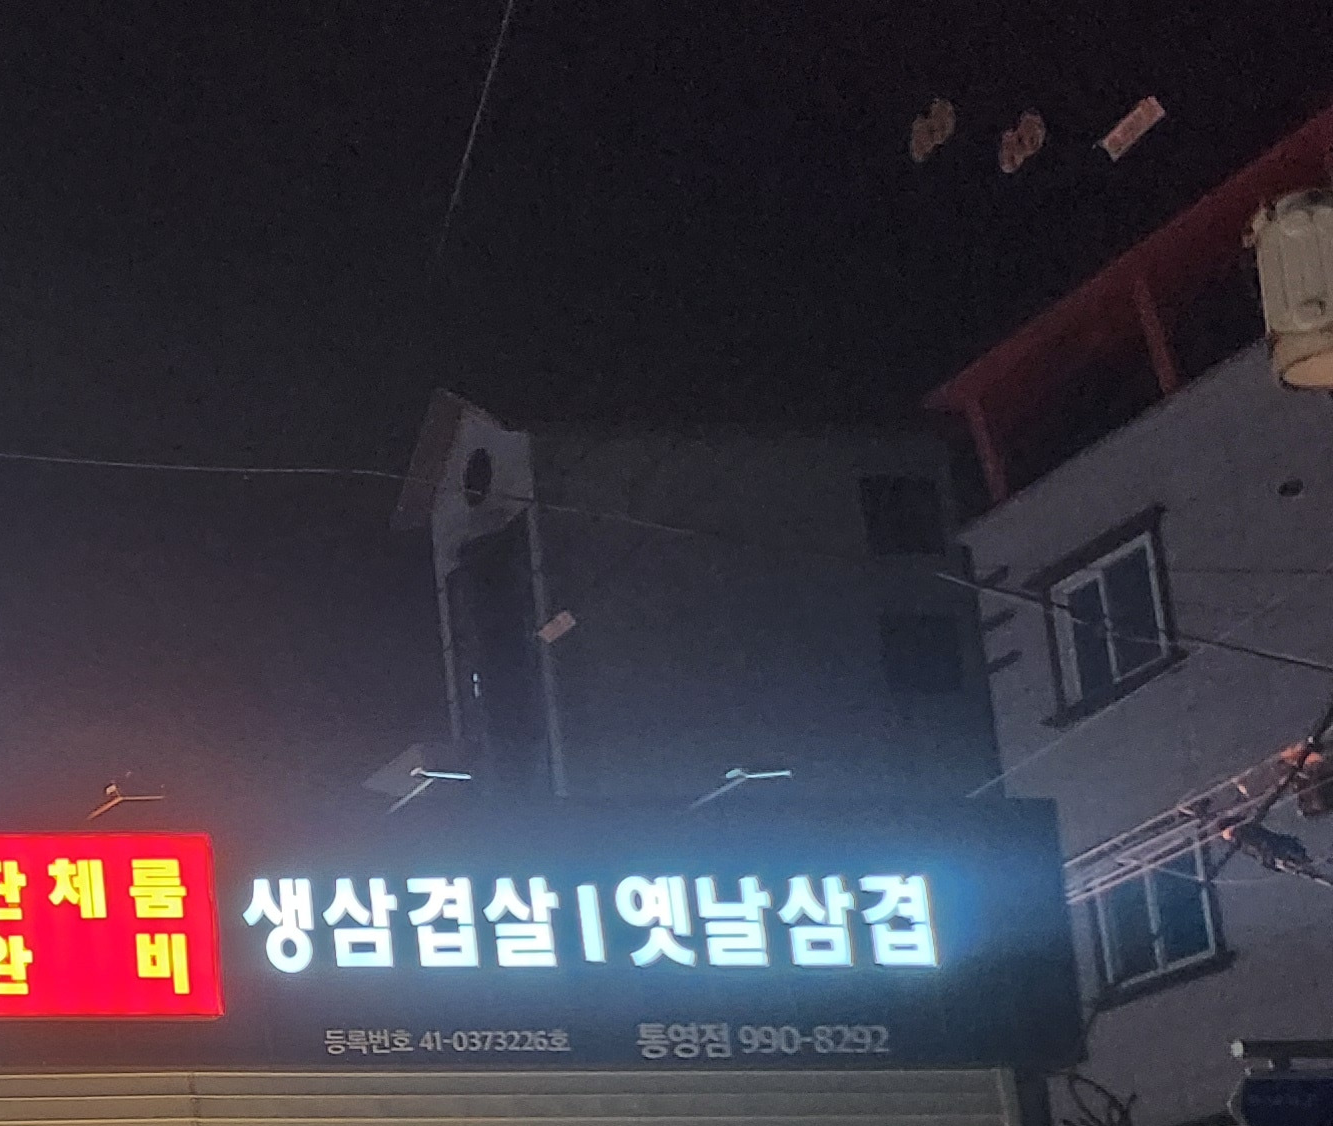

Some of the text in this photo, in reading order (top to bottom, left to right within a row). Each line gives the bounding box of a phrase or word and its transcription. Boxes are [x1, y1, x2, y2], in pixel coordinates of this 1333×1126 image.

[242, 873, 941, 974] 생삼겹살 옛날삼겹
[323, 1029, 572, 1054] 등록번호 41-0373226호
[636, 1022, 890, 1059] 통영점 990-8292
